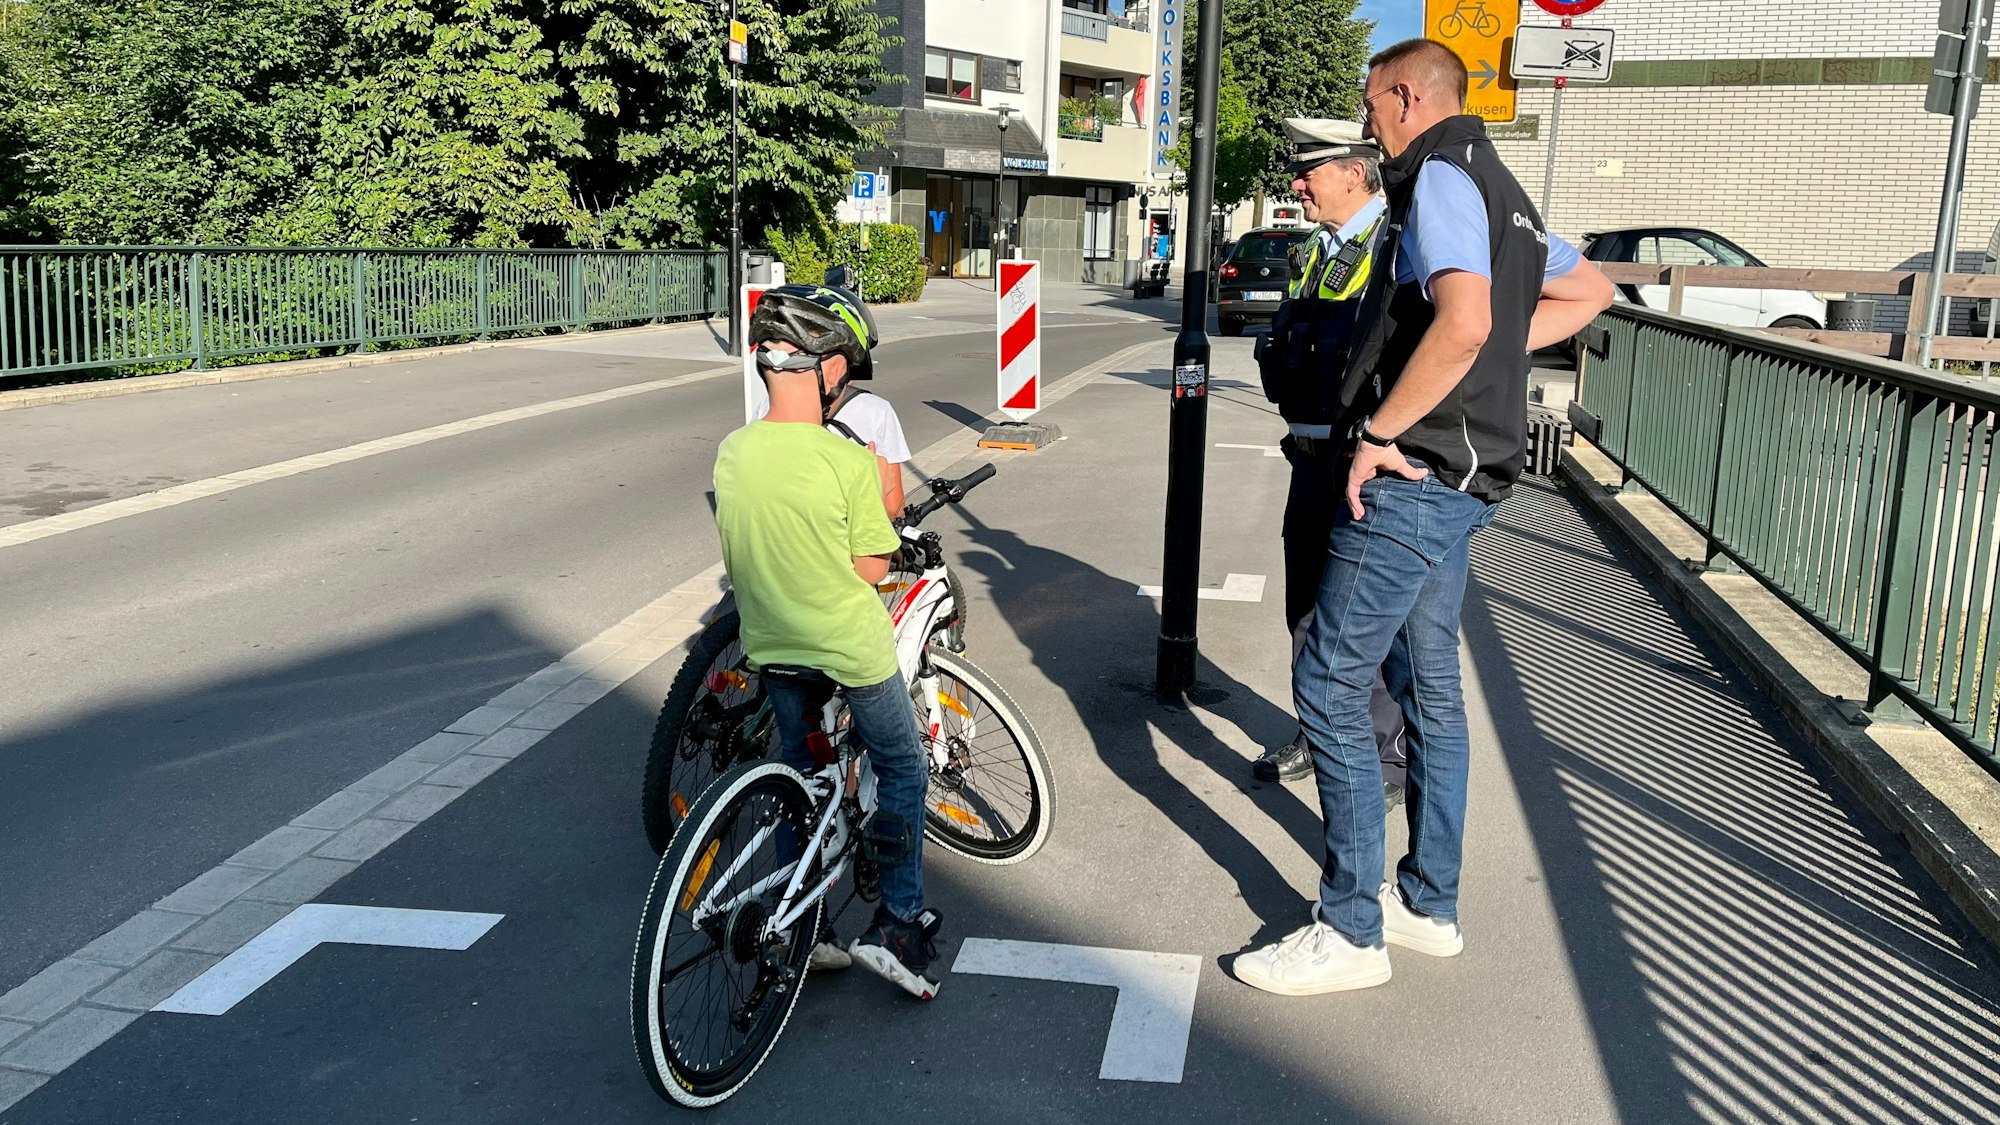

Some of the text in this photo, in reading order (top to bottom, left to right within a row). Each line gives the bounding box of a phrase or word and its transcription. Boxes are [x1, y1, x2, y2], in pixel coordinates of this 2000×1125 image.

[1157, 0, 1177, 166] OLKSBANK
[1003, 157, 1048, 170] VOLKSBANK
[1597, 159, 1608, 168] 23
